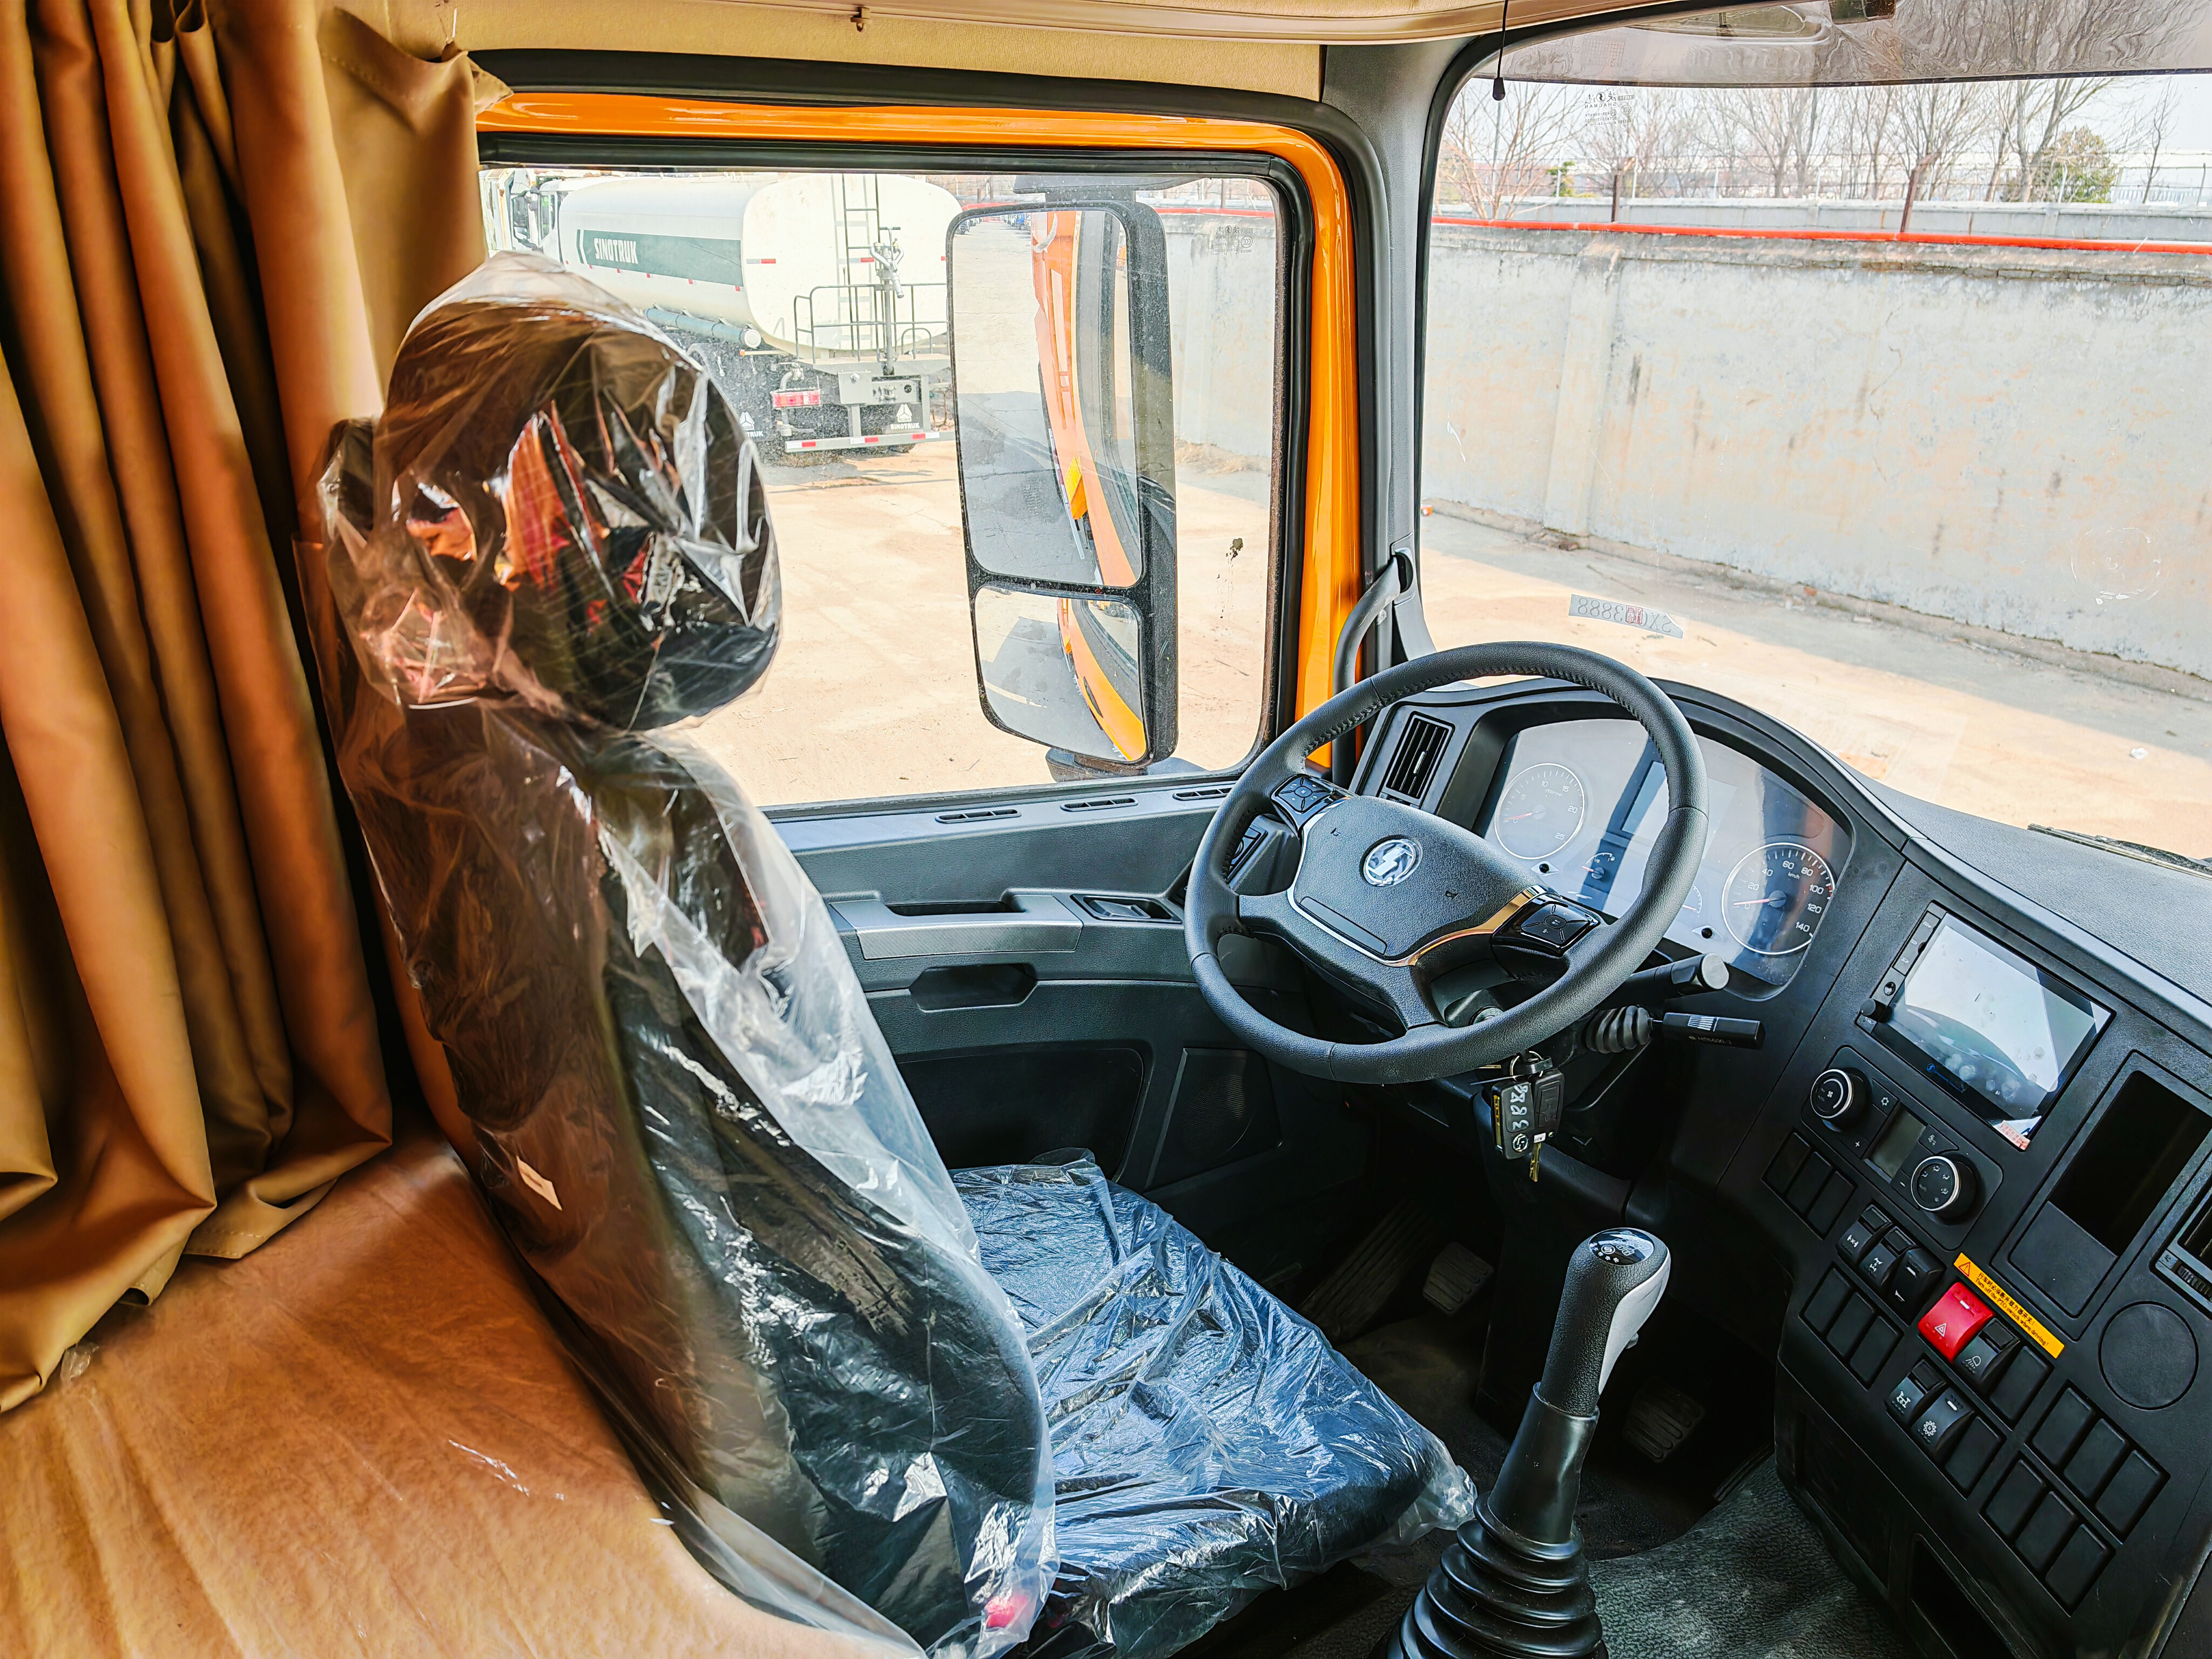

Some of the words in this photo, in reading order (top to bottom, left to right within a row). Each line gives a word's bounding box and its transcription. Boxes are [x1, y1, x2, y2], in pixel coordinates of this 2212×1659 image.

[594, 238, 638, 264] SINOTRUK
[1568, 805, 1578, 813] 20
[1555, 832, 1566, 840] 25
[1782, 860, 1795, 869] 60
[1762, 868, 1773, 876] 40
[1788, 872, 1800, 880] km/h
[1801, 867, 1813, 876] 80
[1748, 882, 1759, 891] 20
[1810, 884, 1824, 895] 100
[1808, 903, 1822, 914] 120
[1796, 921, 1810, 932] 140
[1975, 1278, 1985, 1289] Turn
[1998, 1298, 2007, 1309] PTO
[2006, 1307, 2020, 1321] switch
[2020, 1319, 2032, 1331] when
[2031, 1328, 2049, 1347] driving!
